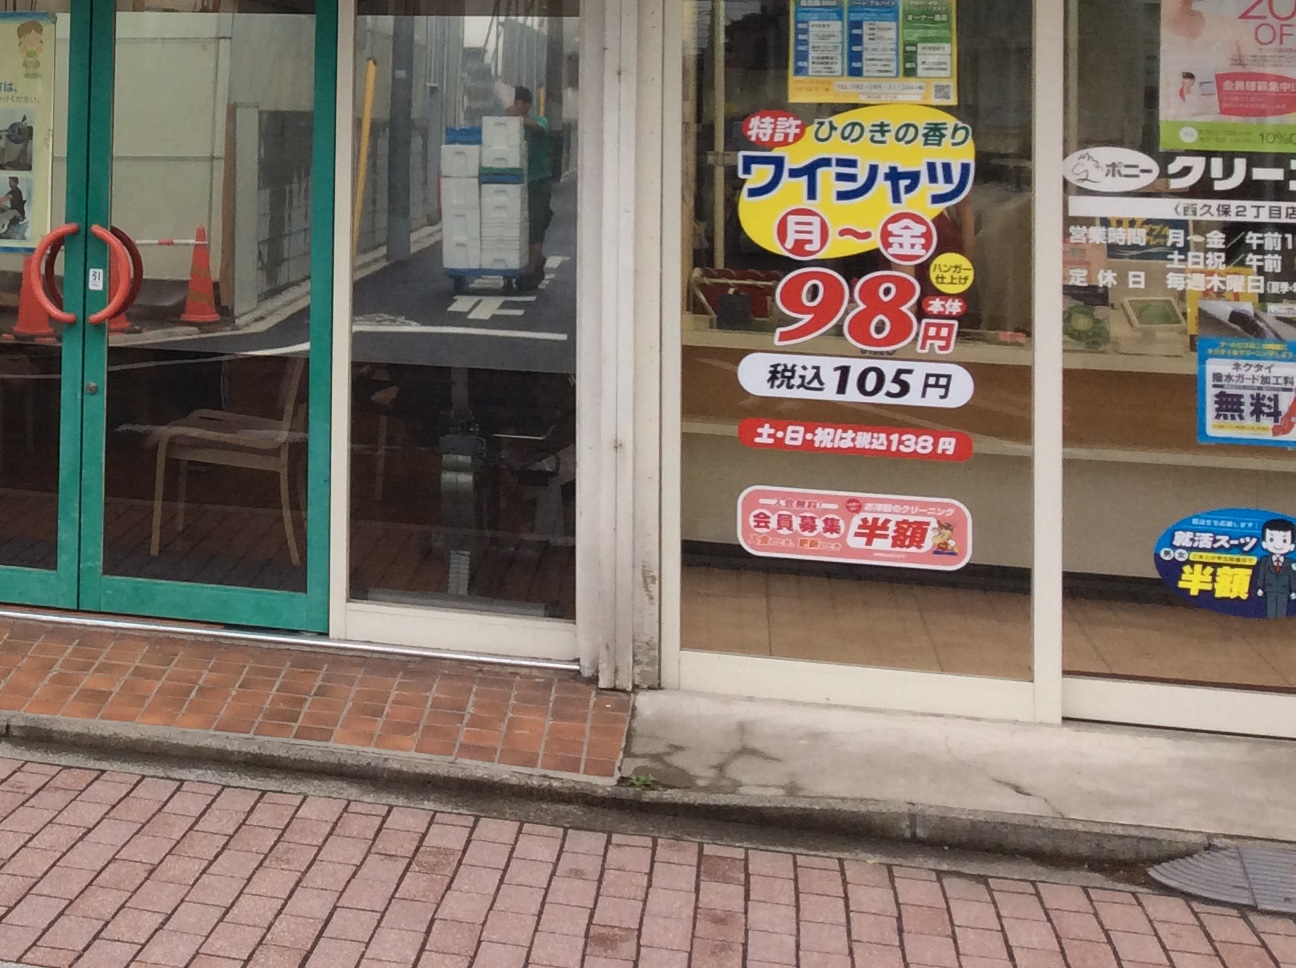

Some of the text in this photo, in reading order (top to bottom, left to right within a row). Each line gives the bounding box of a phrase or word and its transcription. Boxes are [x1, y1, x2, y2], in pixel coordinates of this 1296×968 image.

[747, 115, 972, 147] 特許 ひのきの香り
[740, 154, 972, 205] ワイシャツ
[1105, 155, 1296, 191] ポニー クリー
[1068, 225, 1147, 246] 営業時間
[777, 268, 920, 350] 98
[927, 297, 962, 315] 本体
[919, 321, 955, 351] 円
[766, 362, 953, 400] 税込105円
[1232, 361, 1275, 373] ネクタイ
[1214, 391, 1282, 423] 無料
[753, 511, 931, 550] 会員募集 半額
[1172, 530, 1258, 552] 就活スーツ
[1177, 563, 1253, 601] 半額
